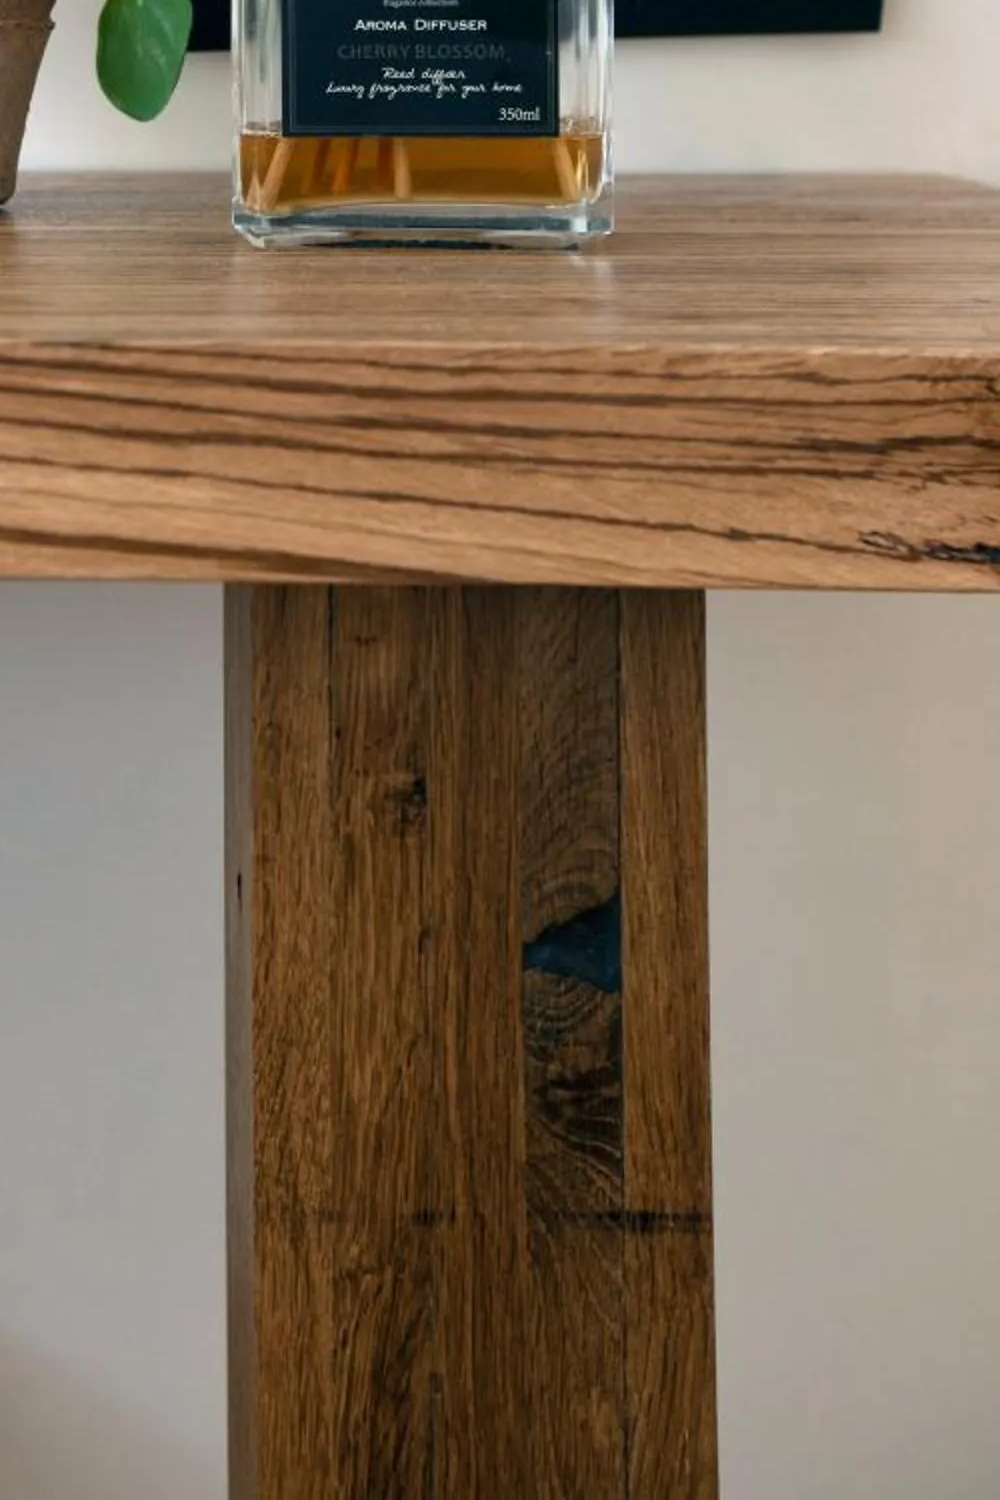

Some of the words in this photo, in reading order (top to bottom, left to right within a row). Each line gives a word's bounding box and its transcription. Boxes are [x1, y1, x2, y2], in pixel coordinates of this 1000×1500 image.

[336, 43, 411, 60] CHERRY
[382, 67, 415, 79] Reed
[368, 82, 431, 100] fragrance
[436, 83, 456, 99] for
[461, 83, 486, 99] your
[492, 81, 521, 93] home
[498, 106, 541, 121] 350ml
